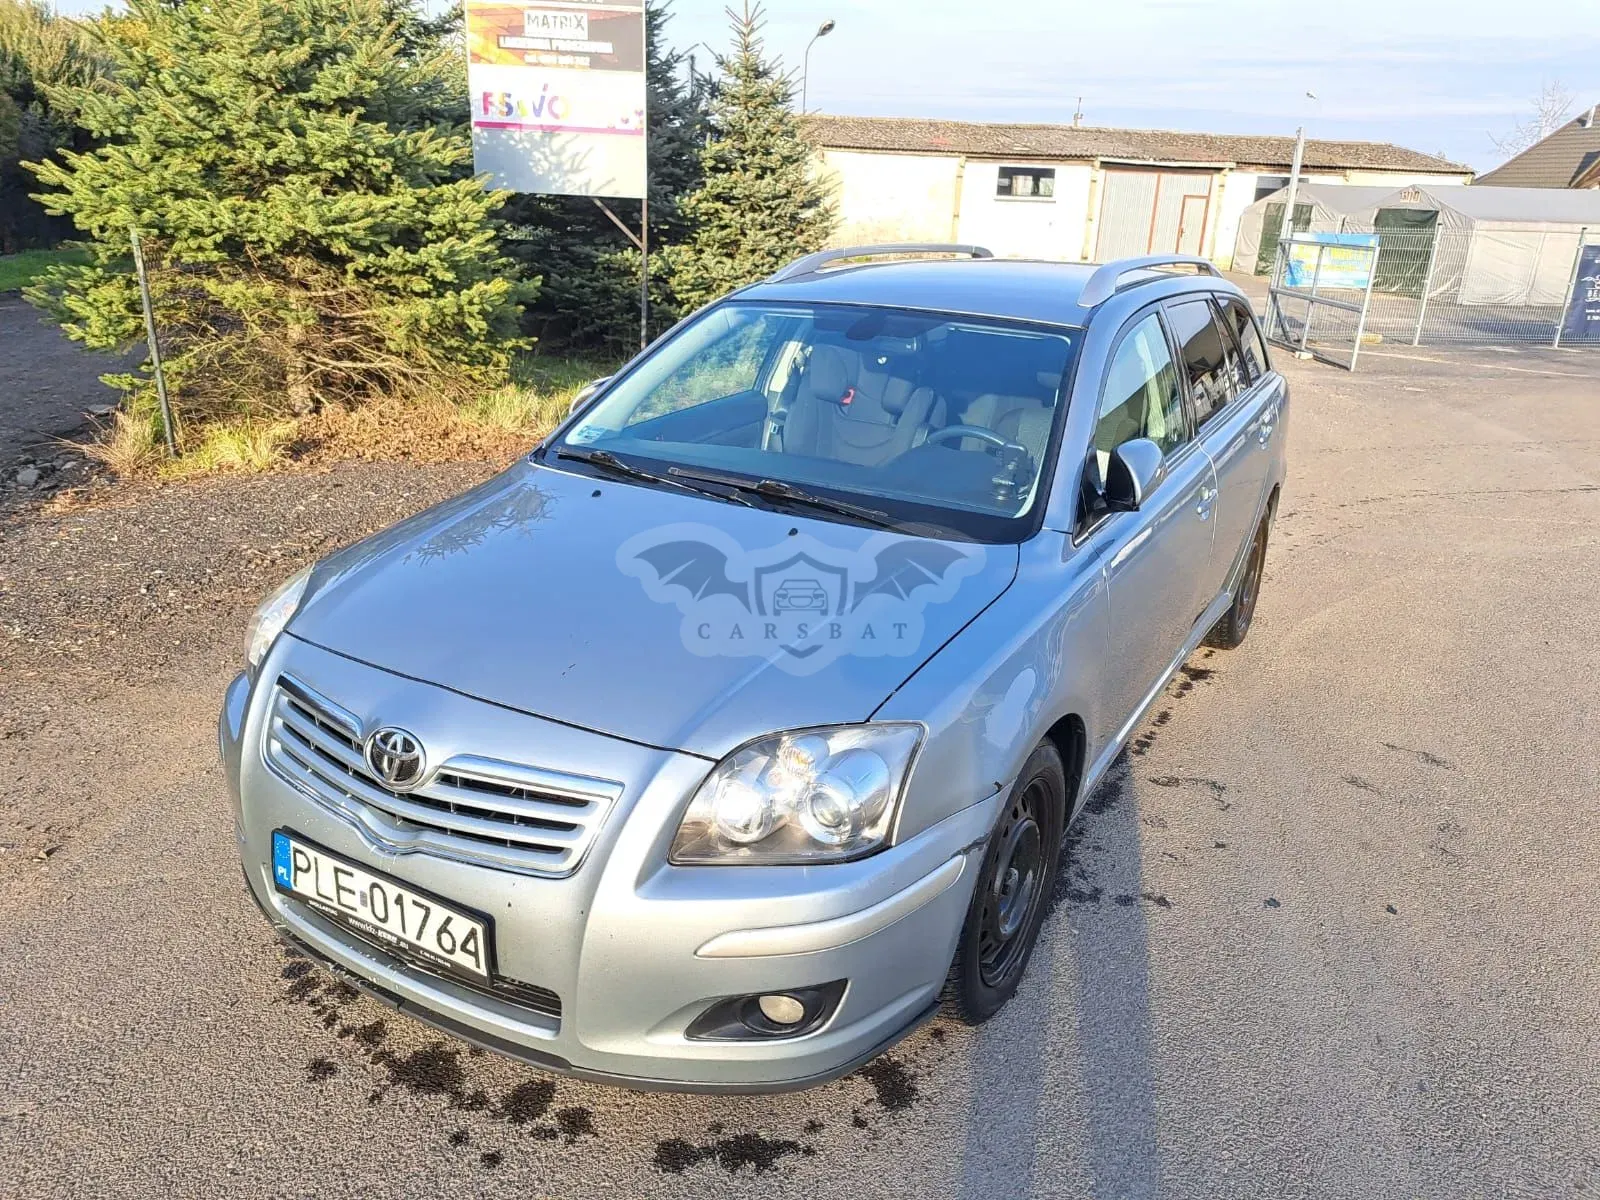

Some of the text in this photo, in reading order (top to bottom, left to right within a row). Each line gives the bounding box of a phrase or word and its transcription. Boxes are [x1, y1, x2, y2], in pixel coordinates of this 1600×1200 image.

[526, 13, 585, 31] MATRIX
[277, 865, 290, 881] PL
[292, 846, 358, 912] PLE
[368, 882, 482, 969] 01764
